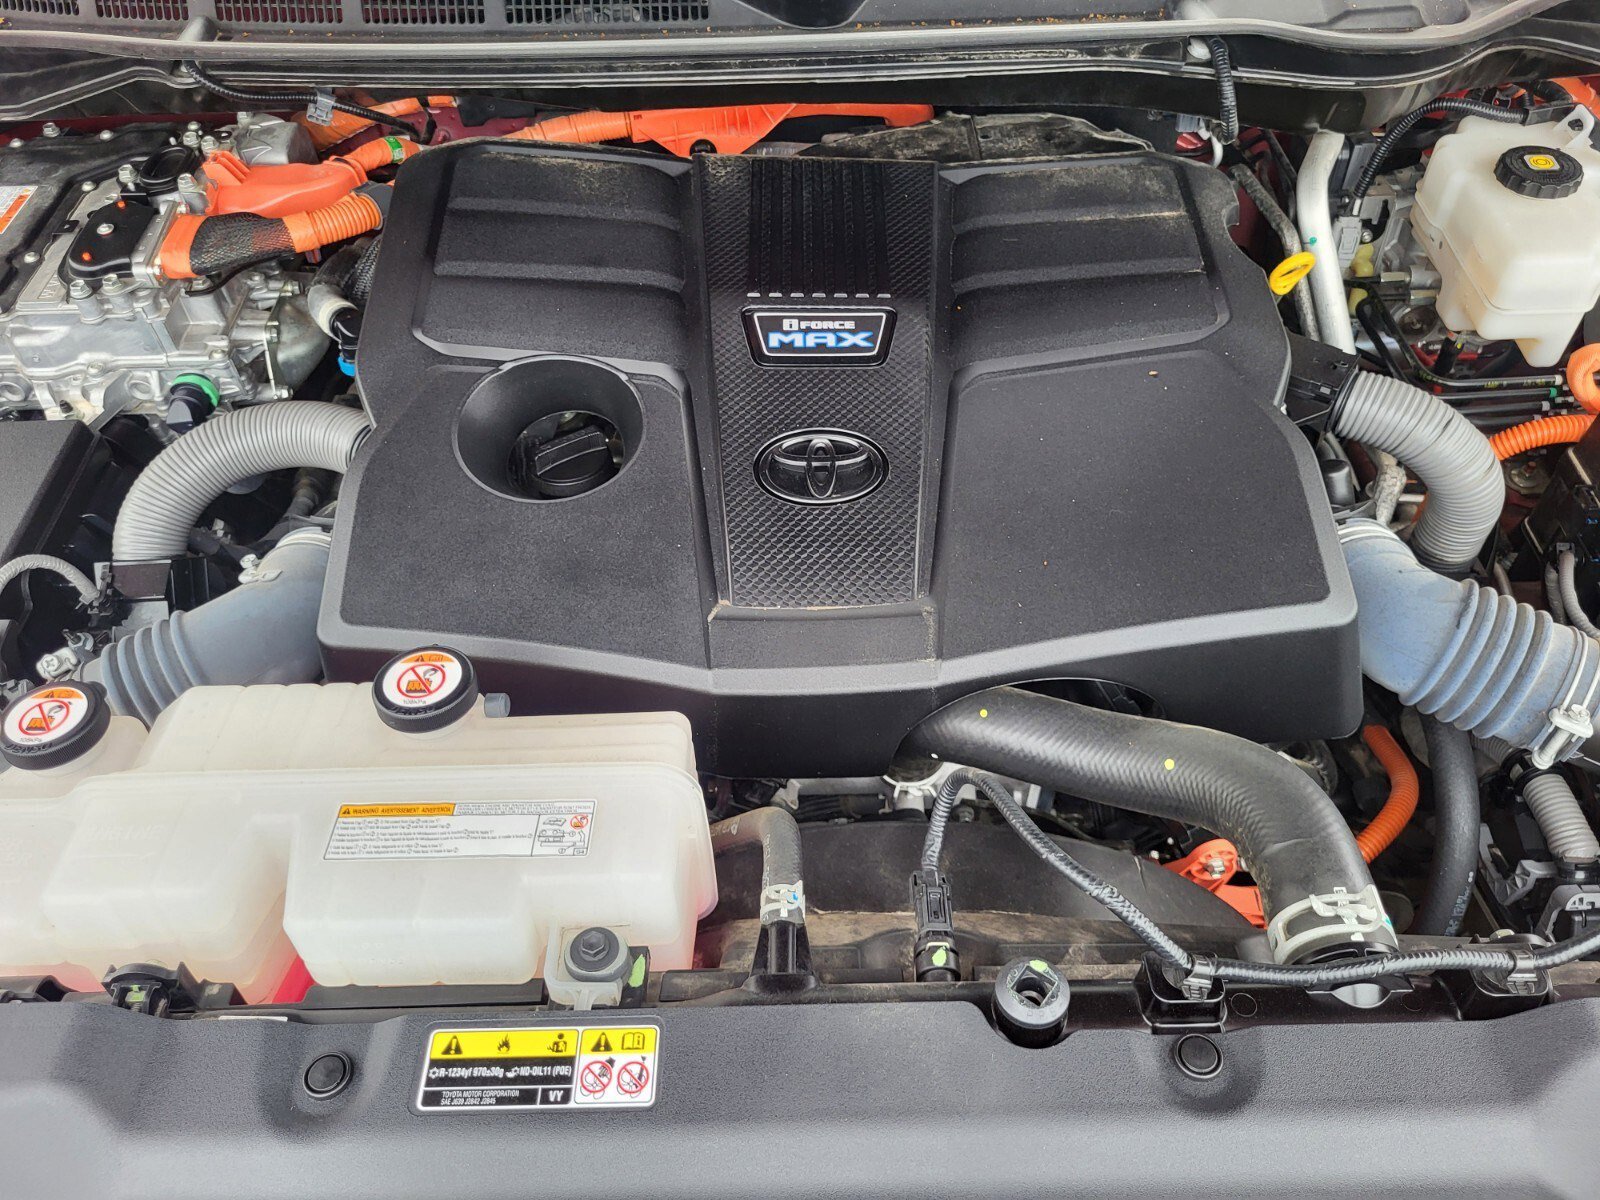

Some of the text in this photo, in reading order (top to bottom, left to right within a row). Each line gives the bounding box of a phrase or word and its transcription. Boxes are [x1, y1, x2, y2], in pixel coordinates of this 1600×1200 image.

[800, 320, 856, 330] FORCE
[767, 331, 874, 348] MAX
[552, 1065, 572, 1077] (POE)
[442, 1090, 462, 1098] TOYOTA
[482, 1089, 520, 1097] CORPORATION
[549, 1090, 564, 1102] VY
